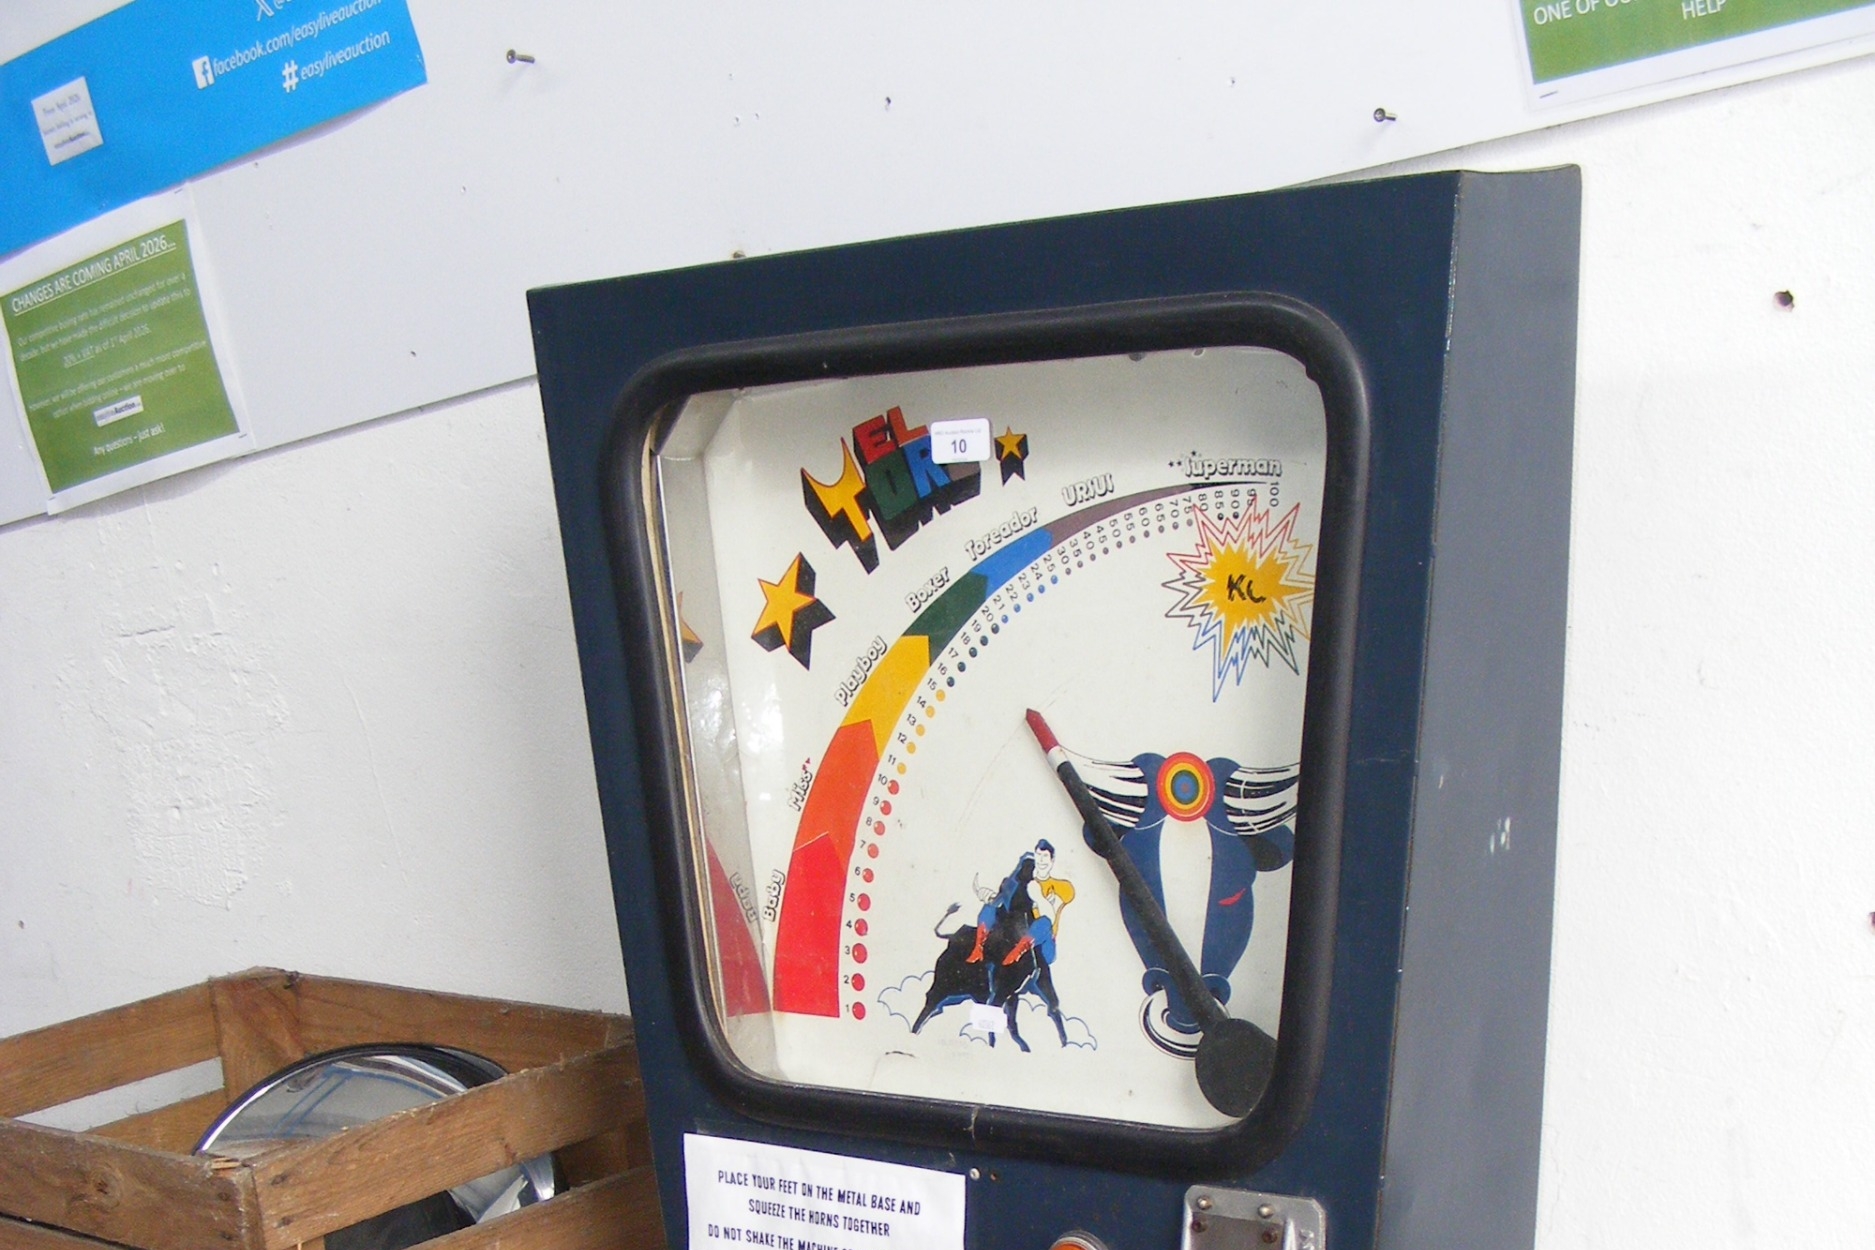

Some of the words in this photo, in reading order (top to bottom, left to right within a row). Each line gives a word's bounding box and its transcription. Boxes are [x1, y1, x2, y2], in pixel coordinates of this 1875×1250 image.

[1533, 0, 1572, 25] ONE
[300, 31, 391, 81] easyliveauction
[11, 284, 54, 312] CHANGES
[54, 275, 74, 295] ARE
[72, 257, 112, 286] COMING
[113, 246, 141, 271] APRIL
[951, 438, 967, 454] 10
[1214, 490, 1224, 510] 85
[1231, 489, 1240, 509] 90
[1268, 481, 1280, 507] 100
[1154, 503, 1166, 523] 65
[1170, 499, 1180, 518] 70
[1182, 495, 1194, 514] 75
[1124, 512, 1136, 532] 55
[1138, 507, 1151, 527] 60
[965, 506, 1037, 561] Toreador
[1095, 525, 1108, 544] 45
[1108, 518, 1121, 538] 50
[1069, 538, 1082, 558] 35
[1082, 531, 1095, 550] 40
[1044, 554, 1056, 573] 25
[1057, 546, 1070, 566] 30
[1030, 563, 1043, 581] 24
[905, 566, 950, 613] Boxer
[1018, 573, 1031, 591] 23
[1005, 584, 1018, 602] 22
[992, 595, 1005, 612] 21
[981, 605, 994, 623] 20
[971, 619, 982, 633] 19
[960, 632, 970, 645] 18
[948, 647, 958, 659] 17
[834, 636, 888, 707] Playboy
[937, 663, 947, 675] 16
[927, 678, 937, 691] 15
[917, 696, 927, 708] 14
[907, 713, 917, 726] 13
[897, 732, 907, 744] 12
[888, 754, 897, 765] 11
[878, 773, 888, 785] 10
[872, 796, 880, 806] 9
[866, 816, 872, 826] 8
[859, 840, 866, 849] 7
[854, 866, 861, 876] 6
[763, 869, 786, 922] Baby
[849, 893, 855, 902] 5
[846, 920, 853, 930] 4
[844, 945, 850, 955] 3
[843, 975, 850, 984] 2
[845, 1004, 849, 1013] 1
[718, 1170, 748, 1186] PLACE
[752, 1174, 775, 1190] YOUR
[779, 1178, 798, 1195] FEET
[802, 1182, 813, 1198] ON
[816, 1186, 833, 1201] THE
[838, 1189, 867, 1207] METAL
[871, 1194, 896, 1212] BASE
[900, 1199, 920, 1216] AND
[749, 1199, 785, 1218] SQUEEZE
[789, 1206, 806, 1222] THE
[809, 1210, 839, 1228] HORNS
[843, 1216, 890, 1237] TOGETHER
[708, 1224, 719, 1238] DO
[724, 1227, 742, 1242] NOT
[746, 1230, 774, 1248] SHAKE
[778, 1236, 794, 1250] THE
